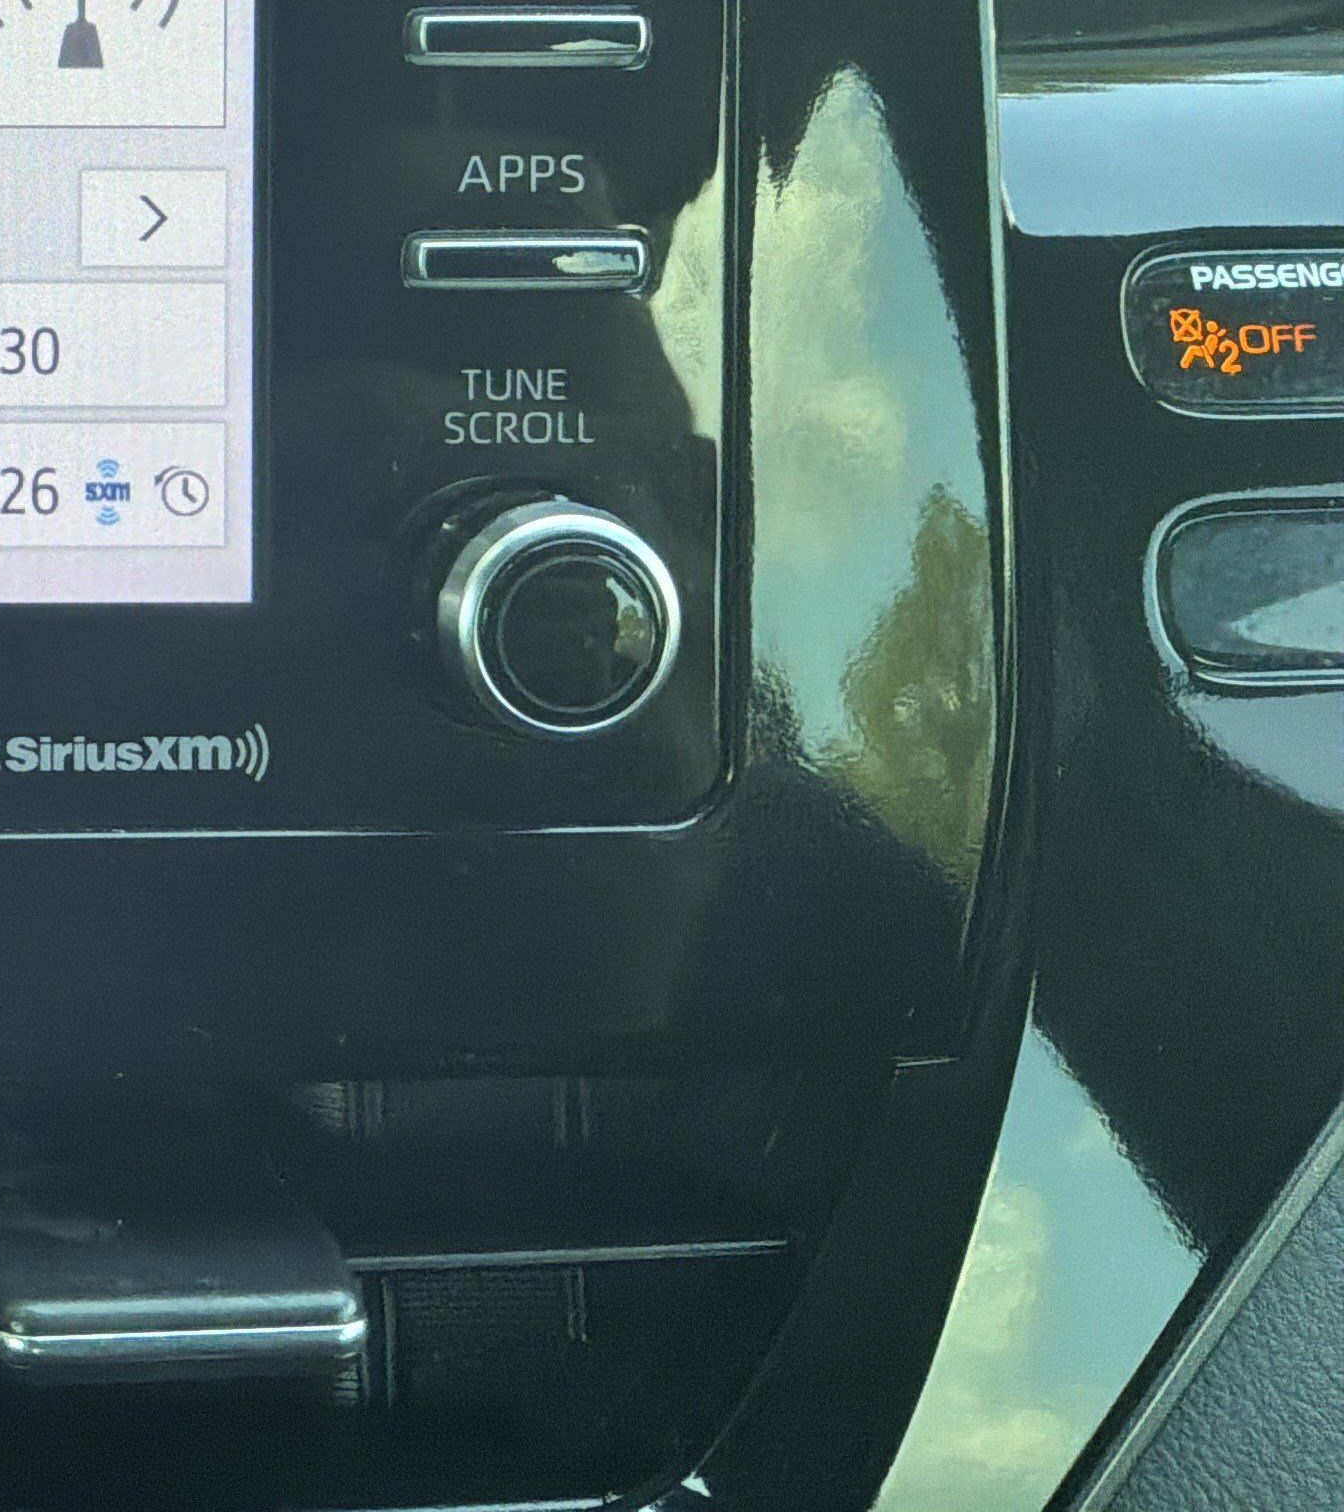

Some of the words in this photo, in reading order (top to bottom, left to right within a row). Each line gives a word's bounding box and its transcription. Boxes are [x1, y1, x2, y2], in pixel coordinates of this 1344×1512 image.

[459, 155, 585, 193] APPS
[1190, 262, 1344, 291] PASSENG
[1238, 324, 1316, 354] OFF
[463, 369, 565, 401] TUNE
[445, 412, 593, 444] SCROLL
